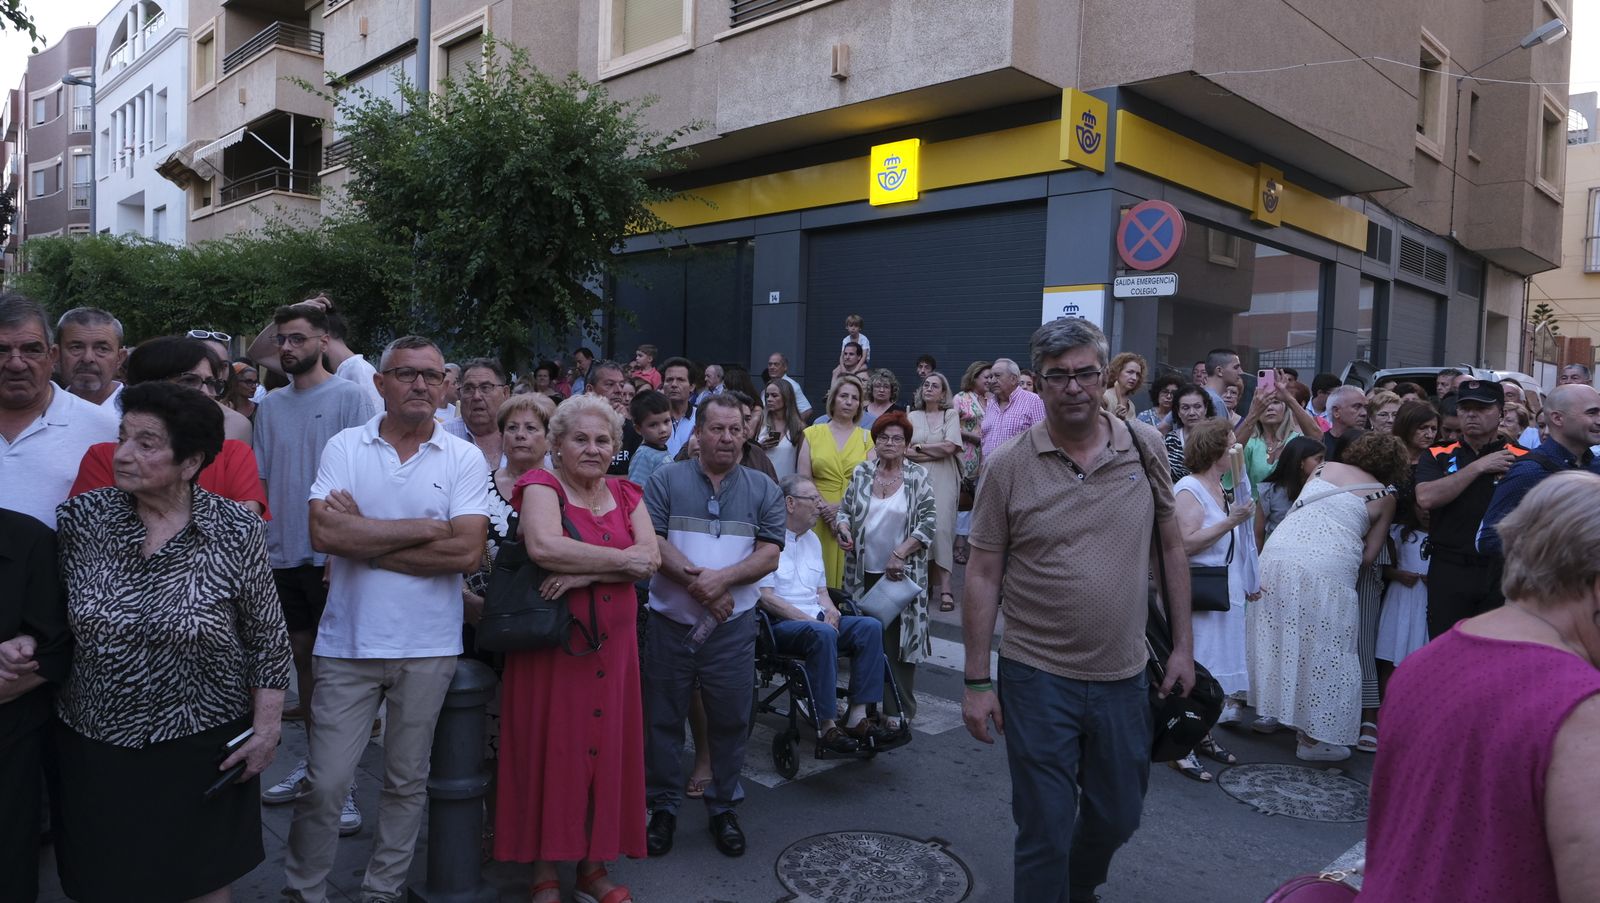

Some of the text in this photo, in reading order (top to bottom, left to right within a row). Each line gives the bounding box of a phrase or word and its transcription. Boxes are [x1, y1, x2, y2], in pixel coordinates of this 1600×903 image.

[1115, 276, 1174, 286] SALIDA EMERGENCIA
[1130, 287, 1158, 295] COLEGIO
[611, 450, 630, 461] ER
